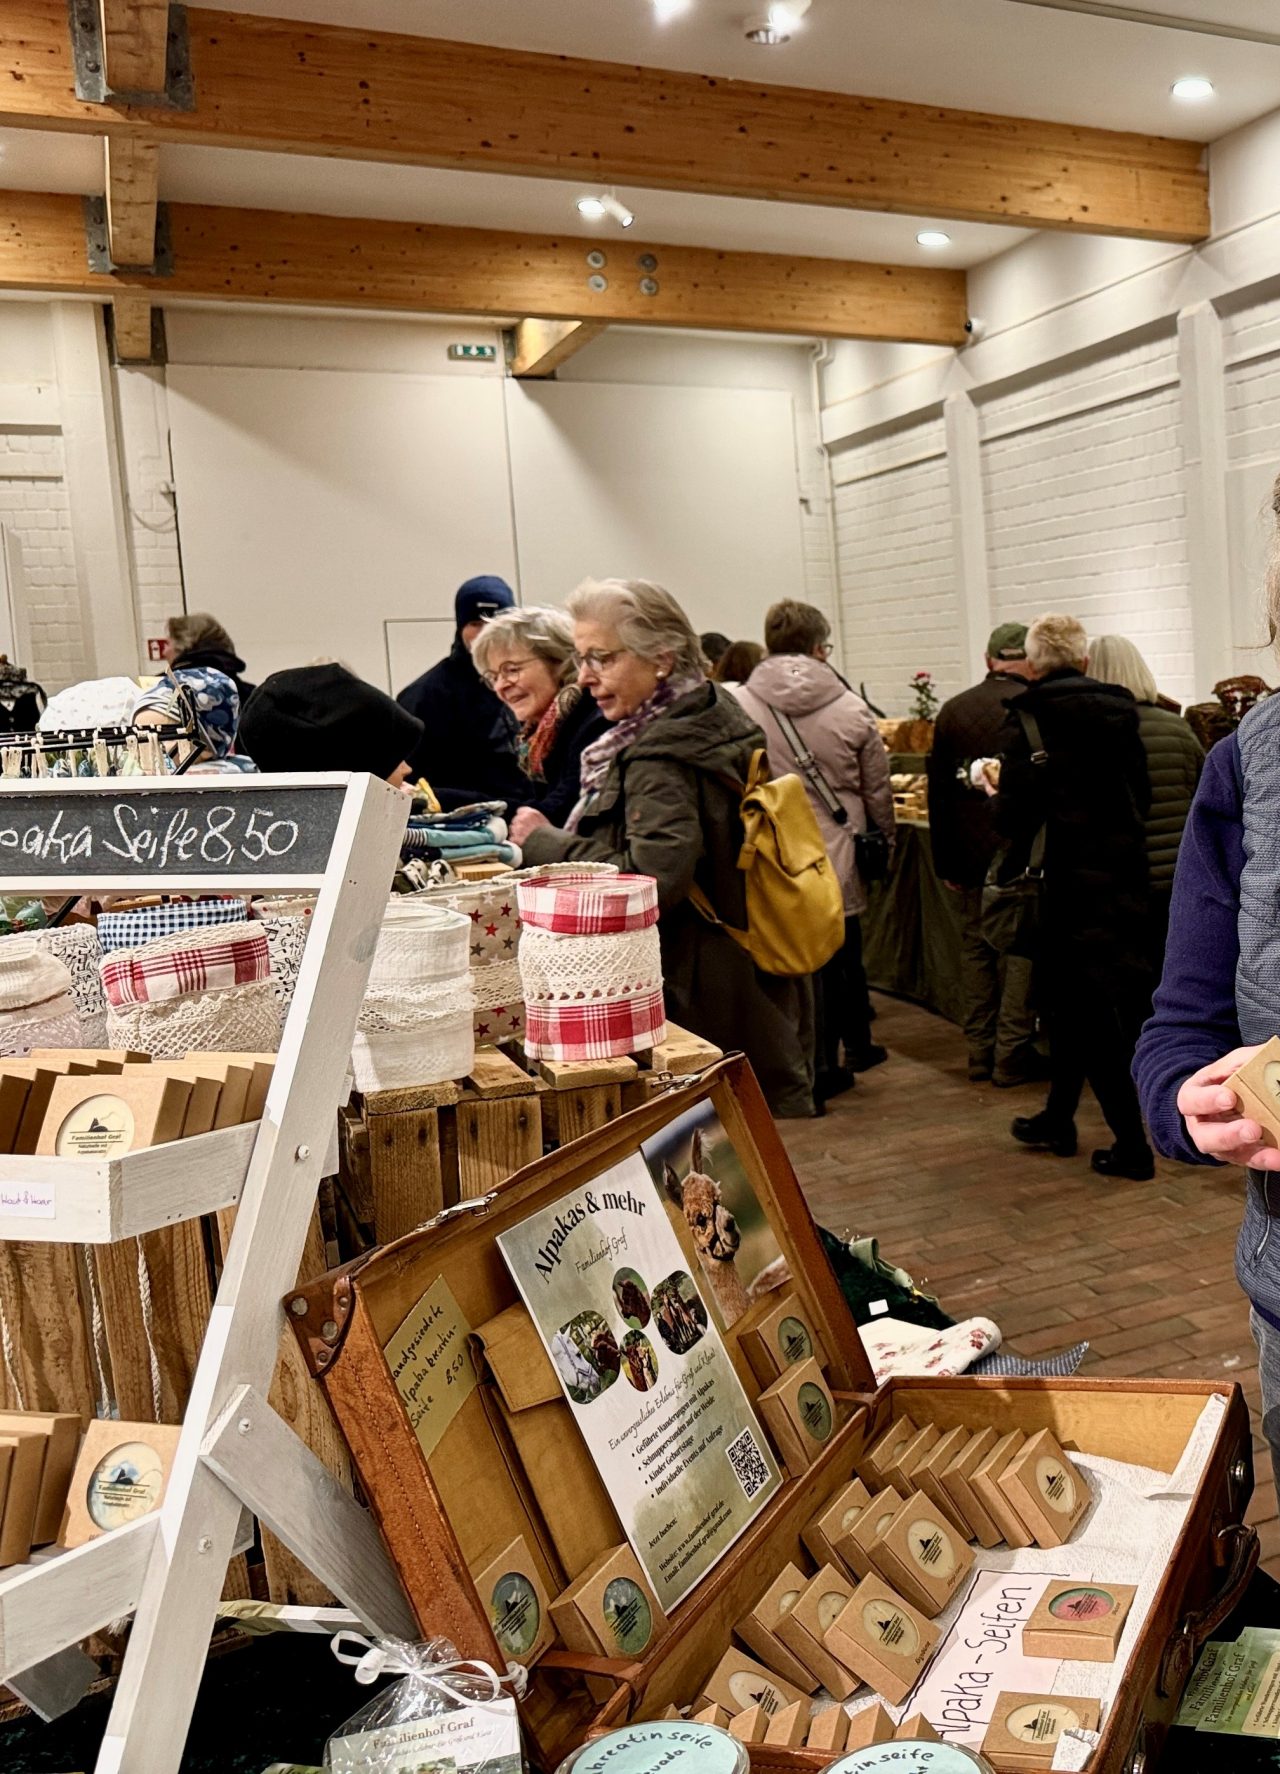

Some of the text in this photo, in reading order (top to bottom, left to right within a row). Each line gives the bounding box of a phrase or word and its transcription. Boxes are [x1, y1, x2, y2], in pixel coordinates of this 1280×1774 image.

[102, 804, 199, 868] Seife
[200, 805, 299, 865] 8,50
[534, 1190, 646, 1284] Alpakas & mehr
[574, 1226, 628, 1274] Familienhof Graf
[391, 1305, 444, 1380] andgesiedete
[445, 1353, 464, 1385] 8,50
[411, 1394, 434, 1429] Seife
[635, 1430, 659, 1455] Geführte
[658, 1402, 691, 1435] Wanderungen
[685, 1413, 696, 1428] auf
[693, 1407, 703, 1422] der
[608, 1438, 621, 1451] Ein
[648, 1434, 695, 1482] Kinder Geburtstage
[655, 1464, 684, 1496] Individuelle
[682, 1452, 700, 1469] Events
[698, 1440, 708, 1454] auf
[1204, 1652, 1246, 1724] Familienhof Graf
[447, 1716, 475, 1732] Graf
[879, 1748, 935, 1762] seife
